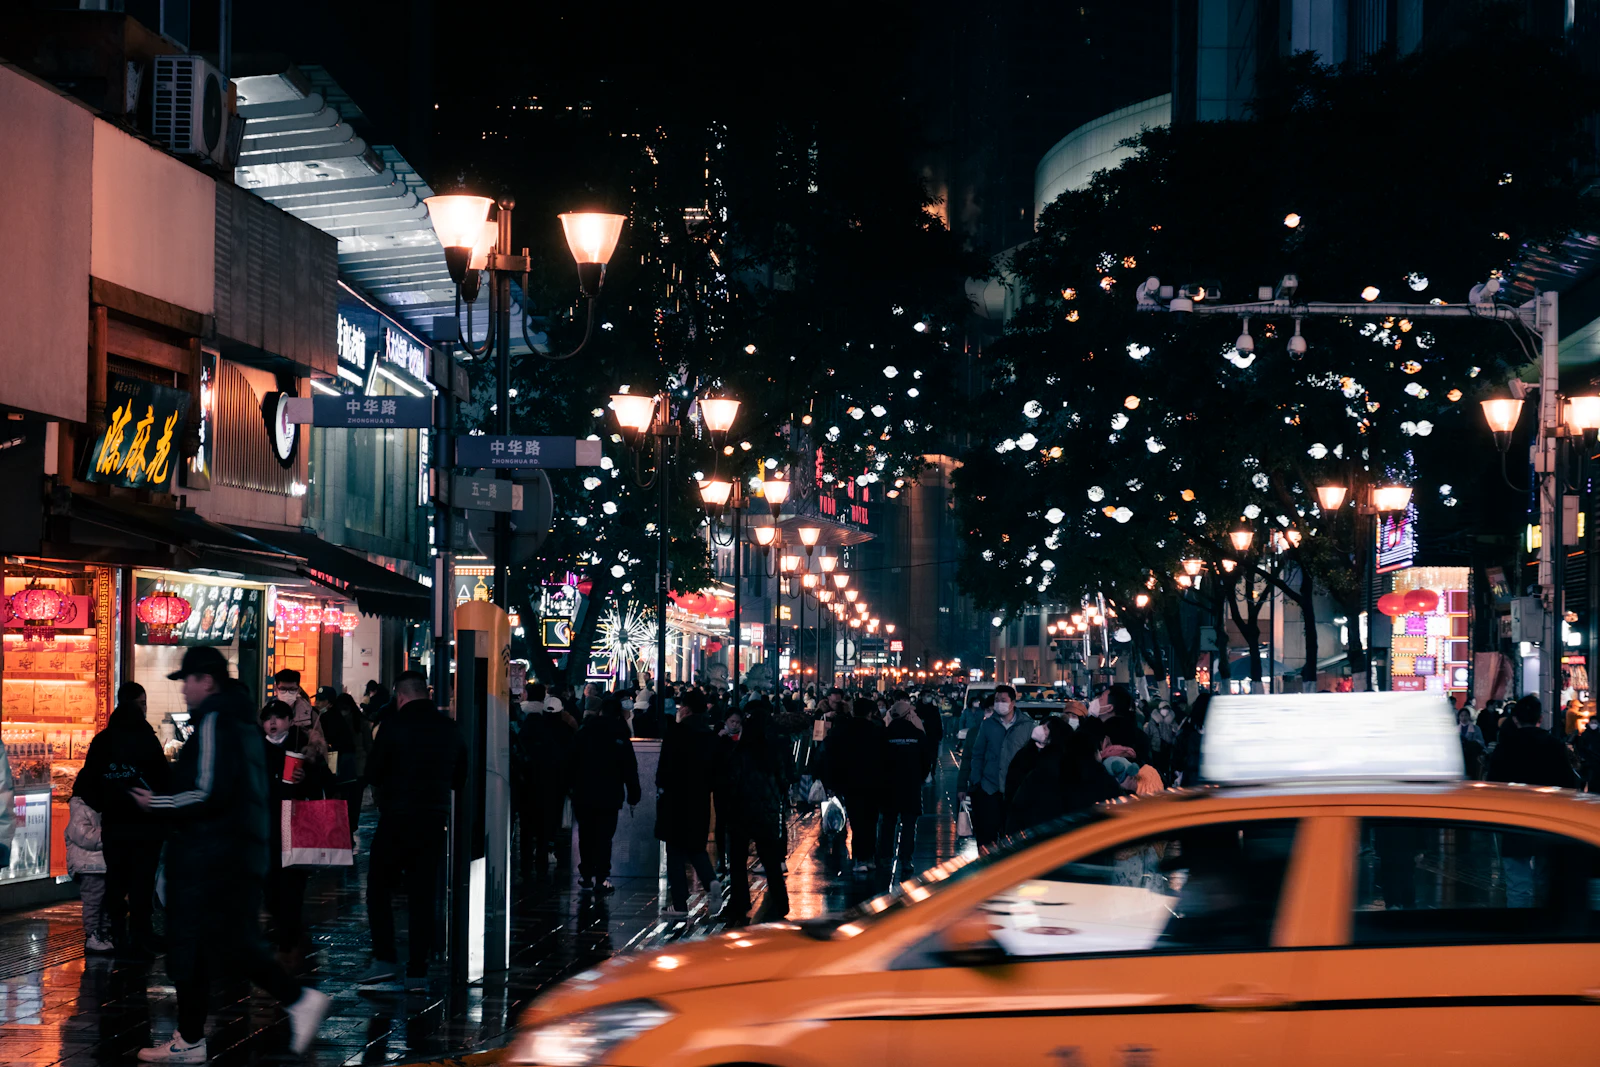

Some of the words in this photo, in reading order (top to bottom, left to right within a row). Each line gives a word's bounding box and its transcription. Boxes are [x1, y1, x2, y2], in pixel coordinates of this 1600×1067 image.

[346, 399, 397, 415] 中华路
[490, 440, 541, 456] 中华路
[471, 482, 497, 499] 五一路
[851, 504, 869, 525] HOTEL
